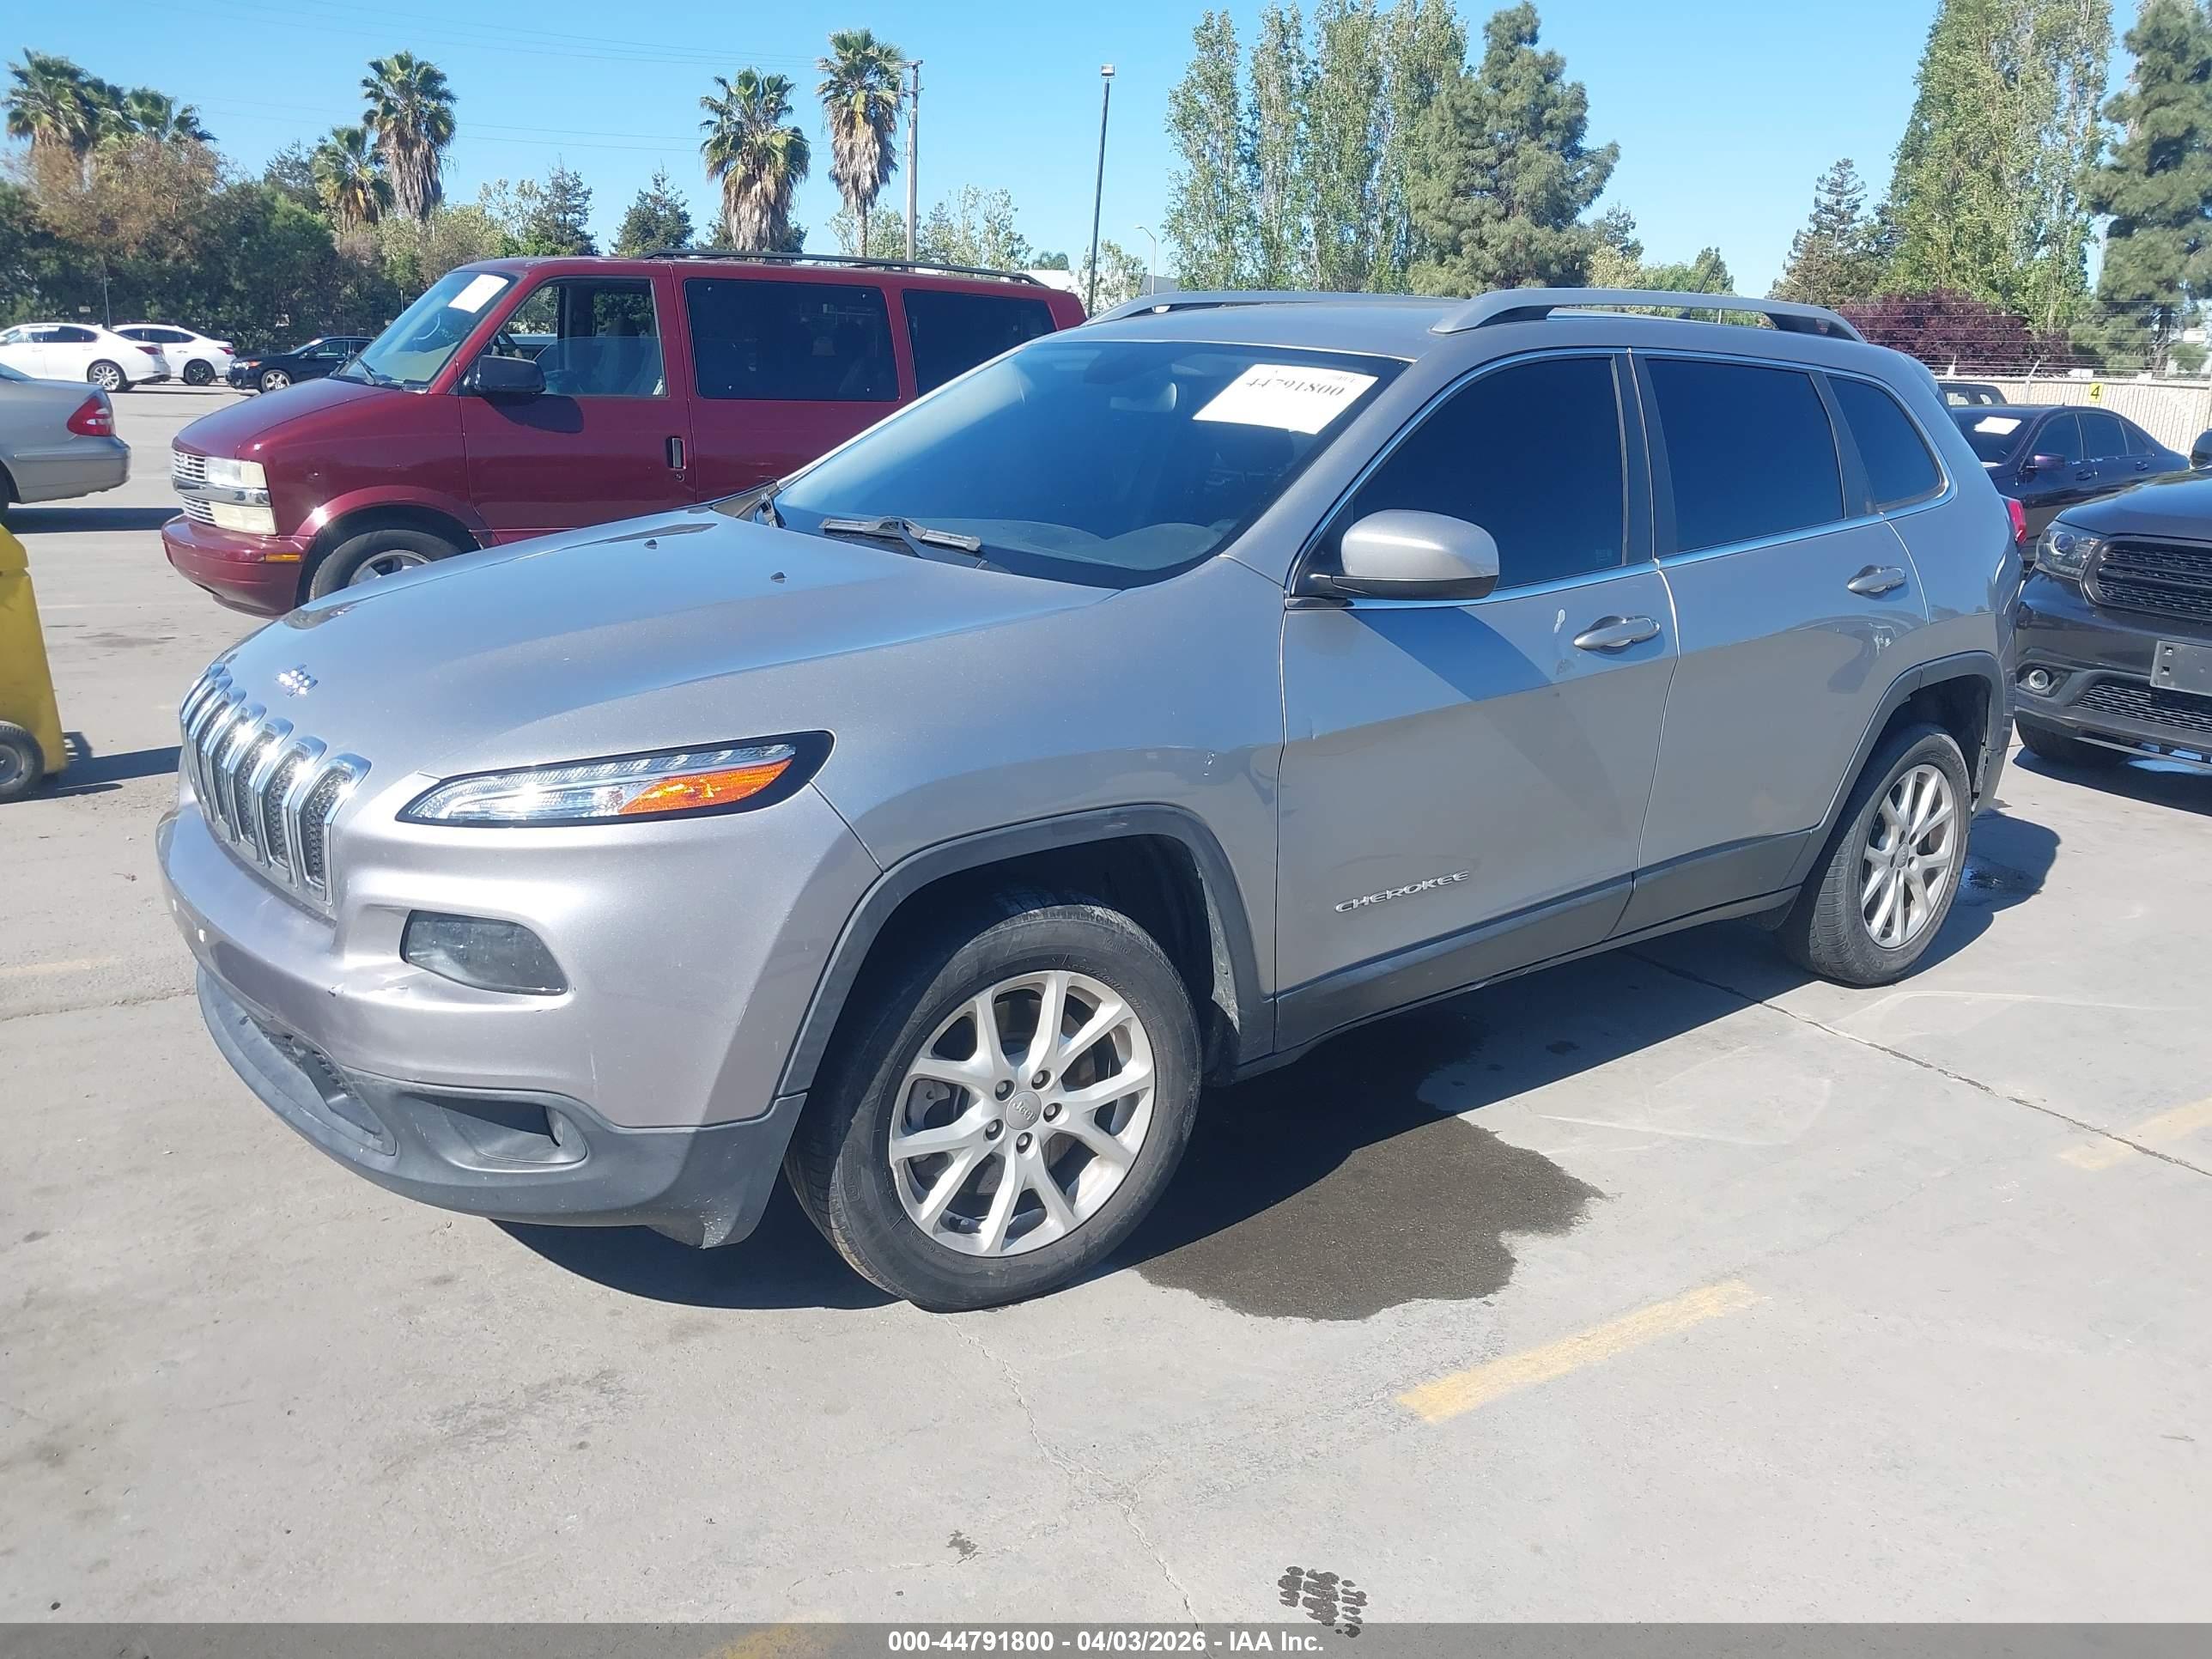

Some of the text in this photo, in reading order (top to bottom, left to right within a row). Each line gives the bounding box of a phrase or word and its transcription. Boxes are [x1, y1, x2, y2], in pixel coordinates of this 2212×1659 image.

[2090, 385, 2100, 400] 4
[1334, 870, 1470, 913] CHEROKEE
[1012, 1100, 1036, 1121] Jeep
